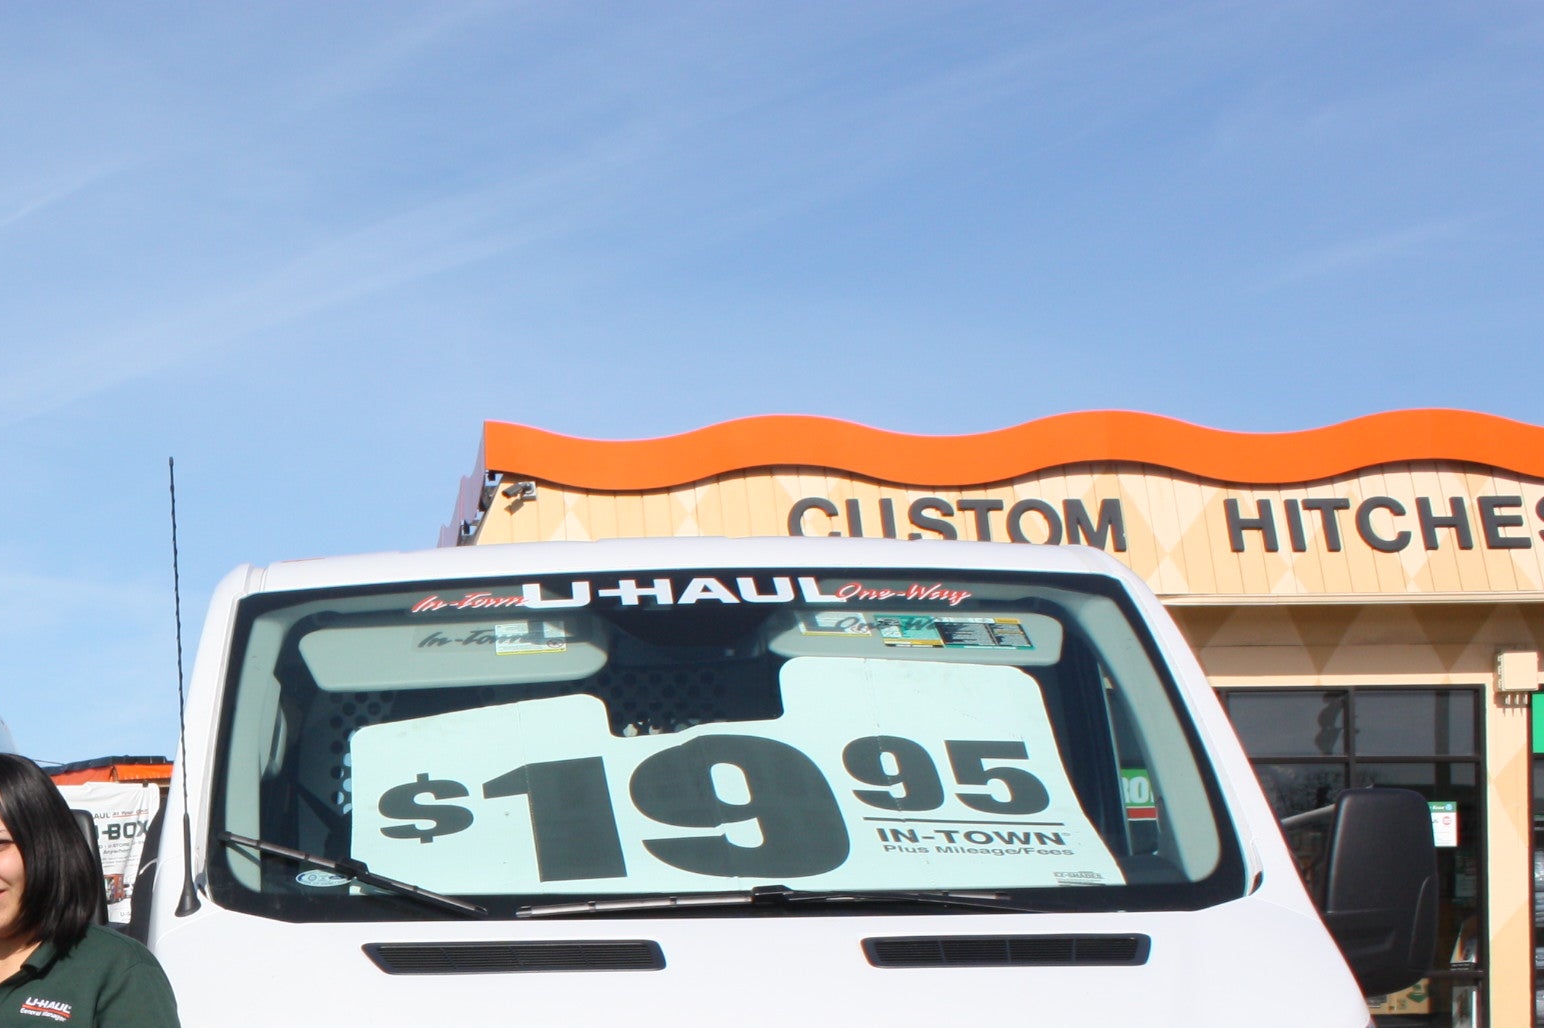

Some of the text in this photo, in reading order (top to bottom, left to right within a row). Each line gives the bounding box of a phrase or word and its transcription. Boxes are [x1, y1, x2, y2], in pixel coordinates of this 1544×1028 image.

[787, 495, 1544, 553] CUSTOM HITCHE
[411, 576, 972, 613] In-Town U-HAUL One-Way
[876, 827, 1067, 846] IN-TOWN
[883, 844, 1075, 856] Plus Mileage/Fees
[25, 996, 70, 1014] U-HAUL
